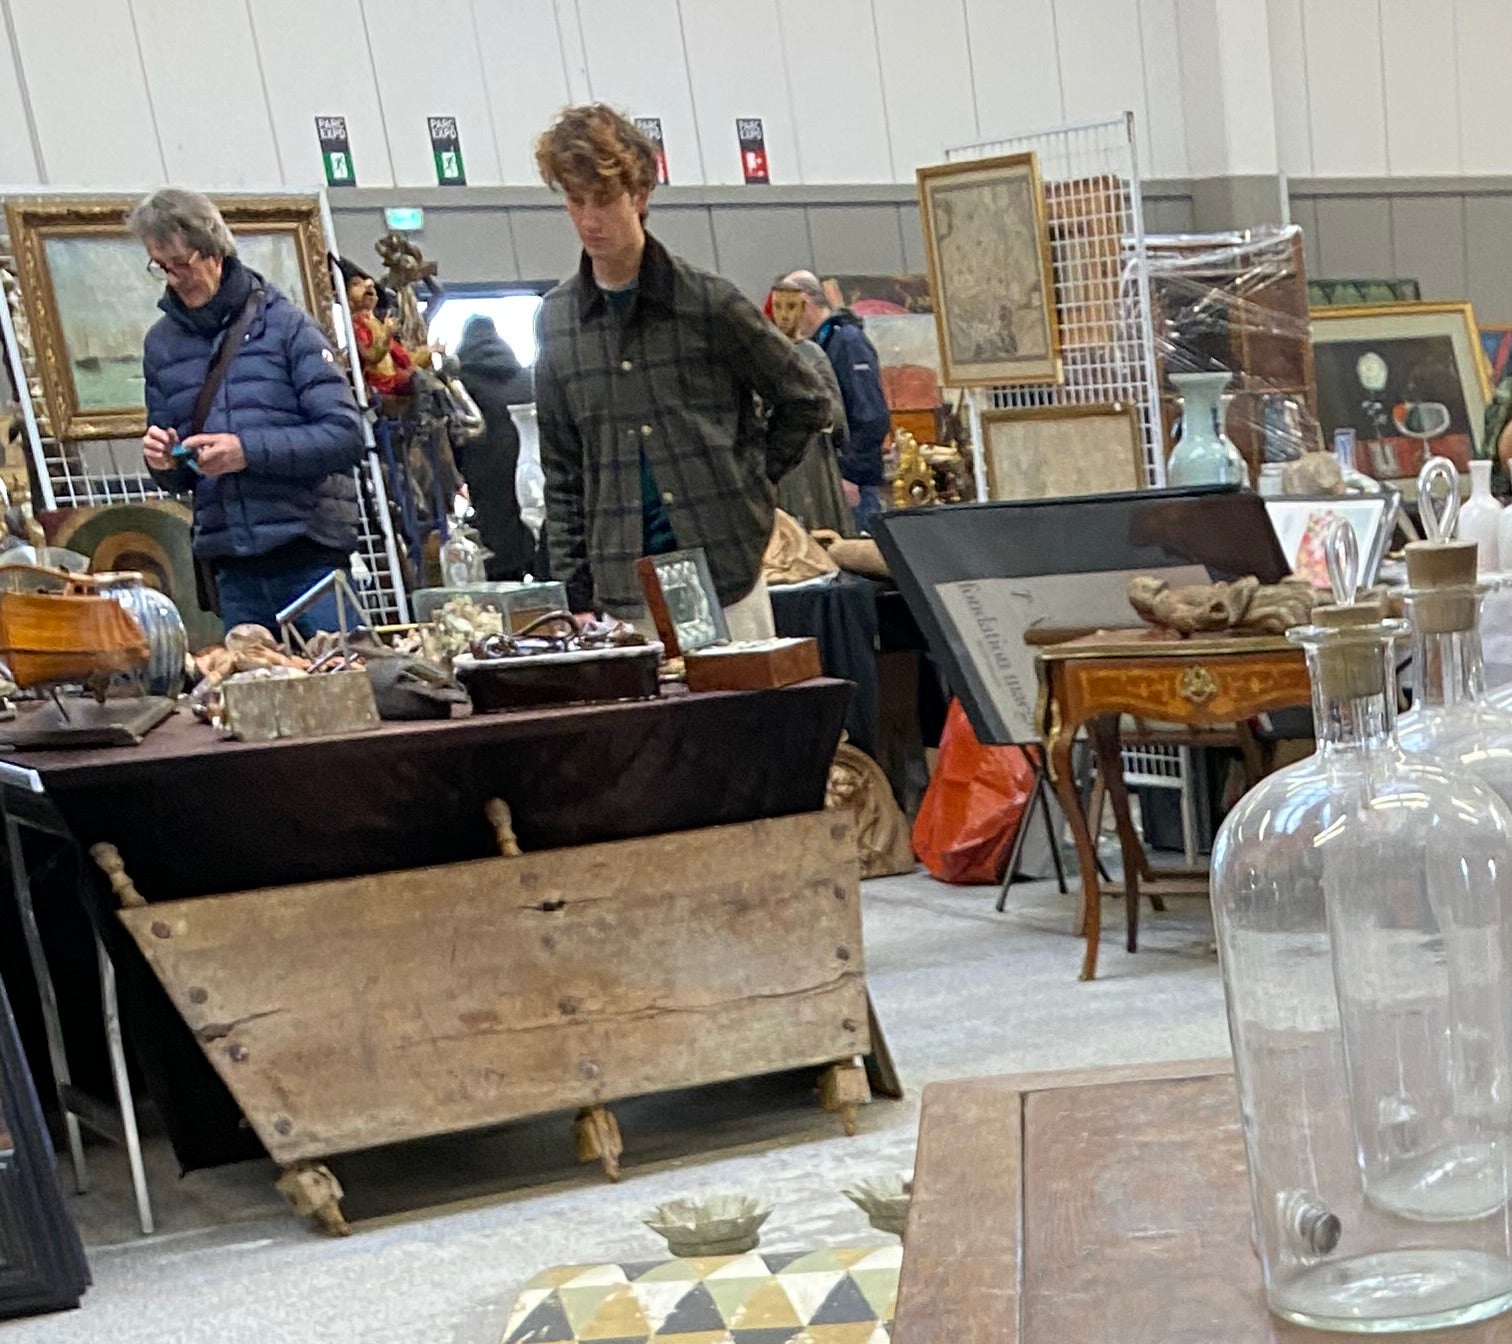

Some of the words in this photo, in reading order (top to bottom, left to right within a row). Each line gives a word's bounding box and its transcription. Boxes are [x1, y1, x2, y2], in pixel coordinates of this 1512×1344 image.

[318, 118, 345, 129] PARC
[431, 118, 455, 129] PARC
[320, 128, 346, 140] EXPO
[432, 128, 457, 139] EXPO
